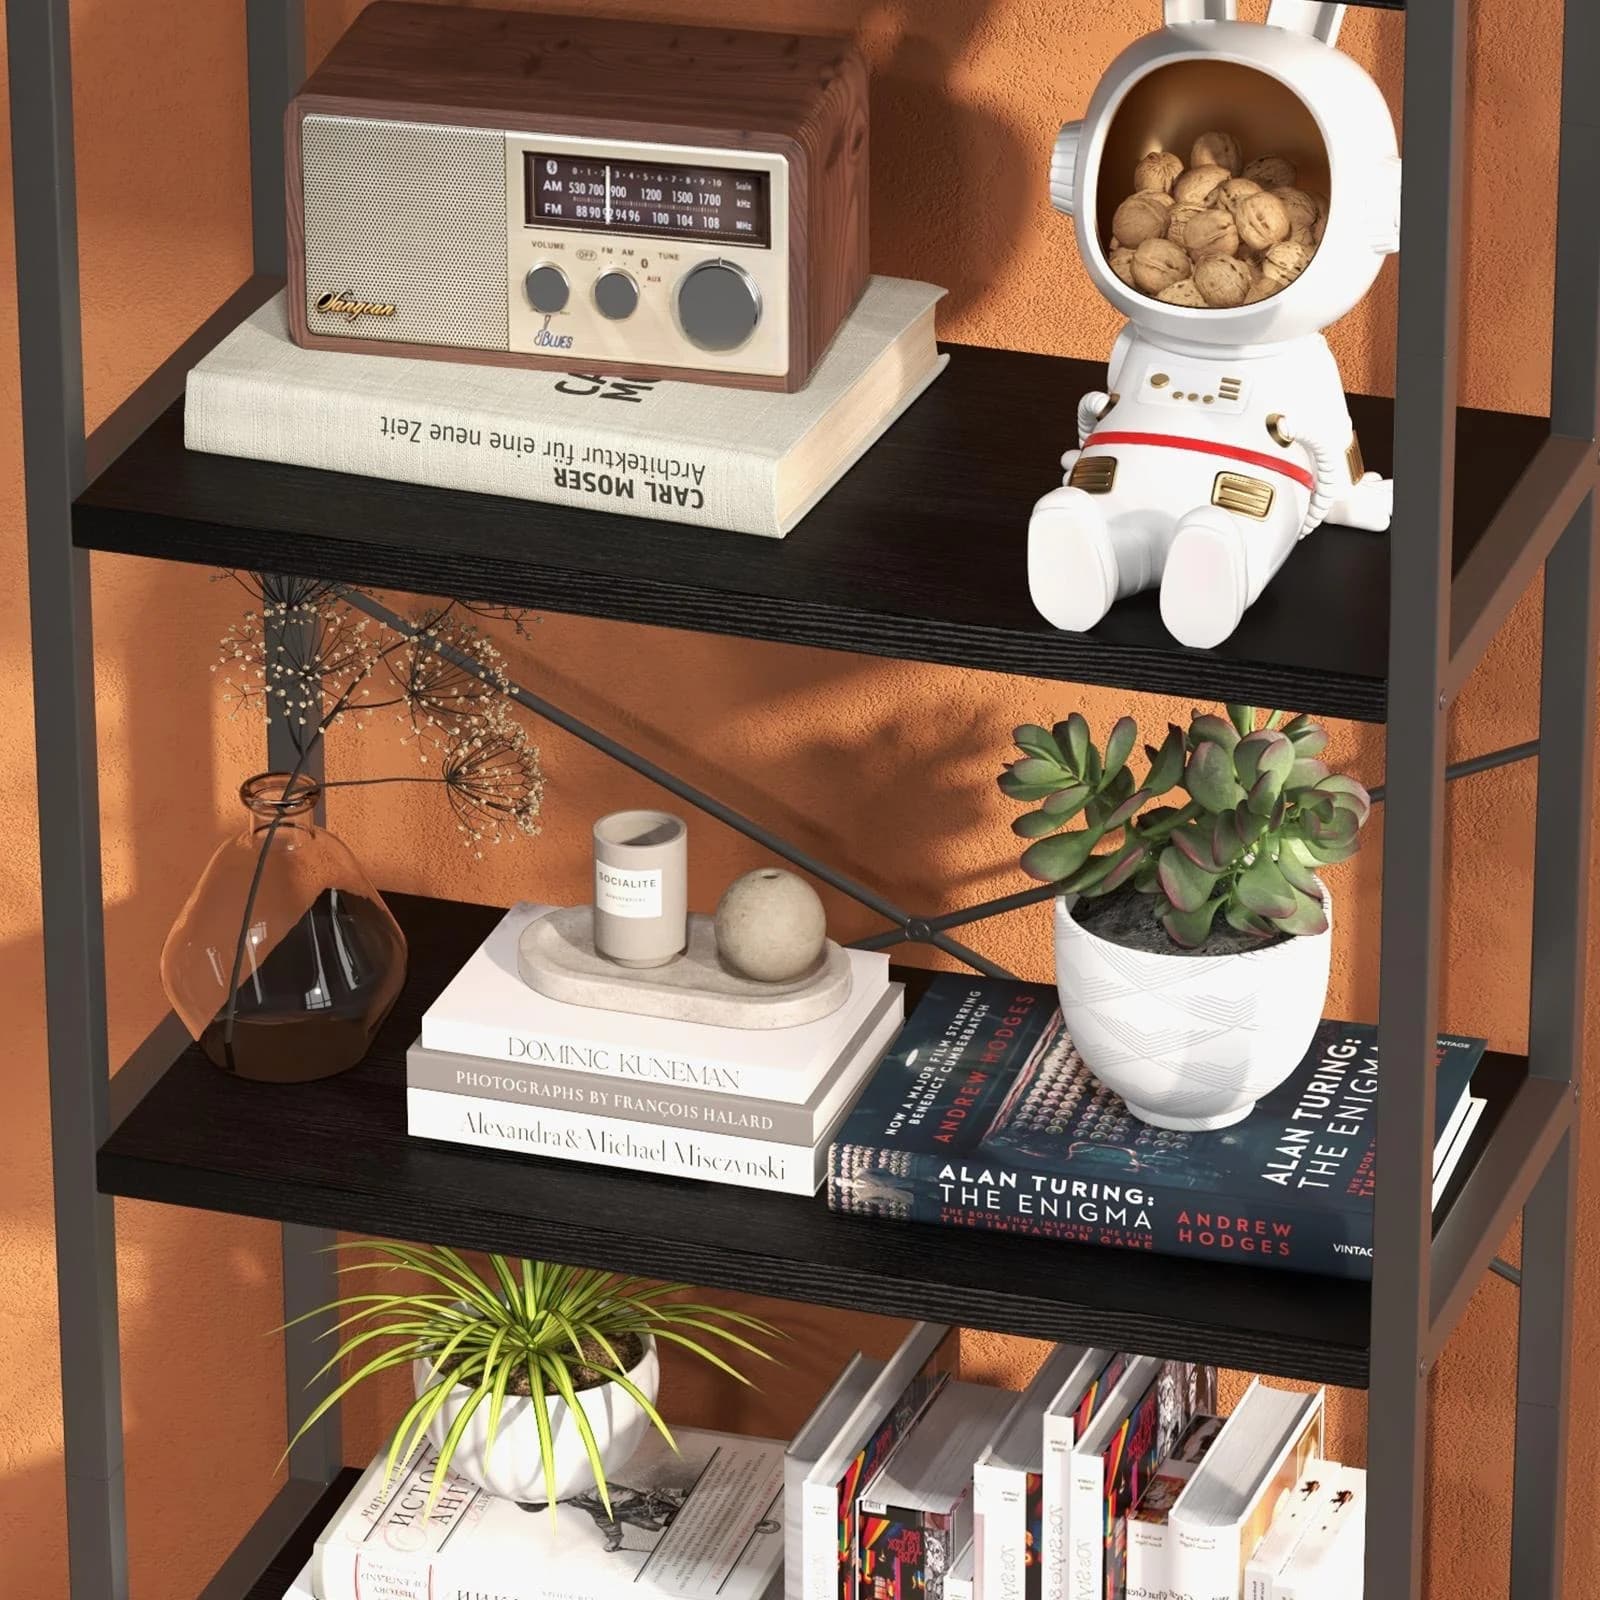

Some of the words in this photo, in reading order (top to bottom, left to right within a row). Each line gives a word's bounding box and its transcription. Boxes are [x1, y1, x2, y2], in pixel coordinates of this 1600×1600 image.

[543, 180, 562, 192] AM
[568, 182, 586, 195] 530
[589, 183, 604, 196] 700
[611, 186, 627, 199] 900
[641, 188, 662, 201] 1200
[672, 190, 693, 204] 1500
[699, 193, 721, 206] 1700
[736, 199, 751, 209] kHz
[712, 179, 722, 187] 10
[544, 203, 562, 215] FM
[576, 205, 587, 217] 88
[589, 206, 601, 218] 90
[616, 209, 627, 221] 94
[628, 210, 640, 222] 96
[652, 212, 669, 225] 100
[677, 213, 693, 227] 104
[703, 215, 720, 229] 108
[736, 221, 752, 231] MHz
[531, 241, 565, 250] VOLUME
[579, 251, 594, 259] OFF
[658, 252, 679, 260] TUNE
[380, 415, 421, 443] Zeit
[430, 423, 481, 446] neue
[490, 431, 535, 459] eine
[543, 440, 574, 465] für
[582, 447, 706, 486] Architektur
[554, 467, 634, 500] MOSER
[644, 481, 704, 509] CARL
[599, 872, 657, 889] SOCIALITE
[945, 990, 982, 1037] STARRING
[508, 1036, 609, 1070] DOMINIC
[620, 1053, 740, 1089] KUNEMAN
[908, 1077, 946, 1125] BENEDICT
[940, 1004, 990, 1073] CUMBERBATCH
[929, 1040, 951, 1063] FILM
[907, 1066, 936, 1099] MAJOR
[932, 1071, 990, 1143] ANDREW
[979, 996, 1035, 1063] HODGES
[456, 1070, 584, 1102] PHOTOGRAPHS
[590, 1090, 609, 1106] BY
[614, 1094, 699, 1119] FRANÇOIS
[703, 1108, 773, 1130] HALARD
[902, 1102, 914, 1110] A
[1261, 1128, 1315, 1186] ALAN
[1291, 1038, 1362, 1120] TURING:
[884, 1112, 907, 1136] NOW
[1297, 1144, 1349, 1188] THE
[1326, 1046, 1378, 1136] ENIGM
[673, 1141, 785, 1180] Misczynski
[939, 1164, 1017, 1188] ALAN
[1031, 1175, 1154, 1207] TURING:
[939, 1183, 1001, 1210] THE
[1019, 1194, 1152, 1230] ENIGMA
[940, 1215, 976, 1226] THE
[987, 1220, 1089, 1241] IMITATION
[1100, 1236, 1152, 1249] GAME
[942, 1207, 963, 1215] THE
[968, 1211, 1000, 1220] BOOK
[1006, 1215, 1033, 1225] THAT
[1040, 1220, 1093, 1233] INSPIRED
[1100, 1227, 1120, 1236] THE
[1126, 1231, 1152, 1240] FILM
[1177, 1210, 1292, 1238] ANDREW
[1178, 1228, 1290, 1257] HODGES
